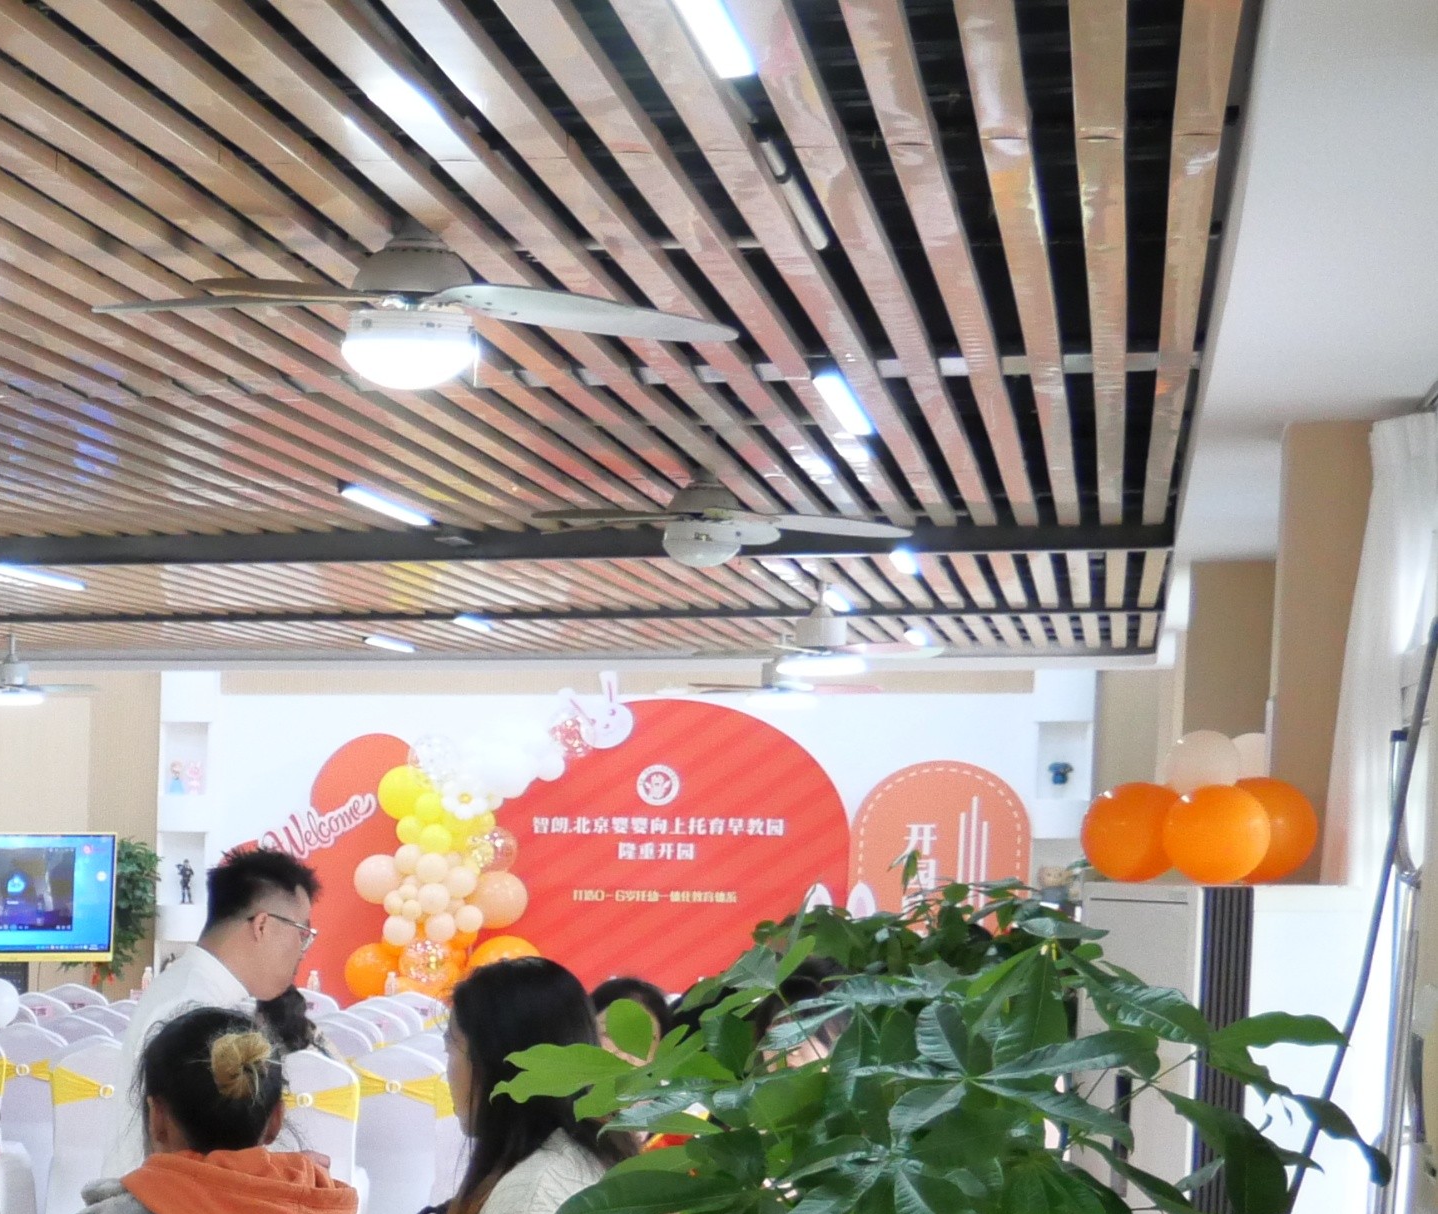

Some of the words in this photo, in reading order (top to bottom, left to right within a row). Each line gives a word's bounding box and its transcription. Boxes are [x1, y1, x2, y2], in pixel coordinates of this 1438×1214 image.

[262, 797, 373, 856] Welcome
[618, 842, 696, 860] 隆重开园
